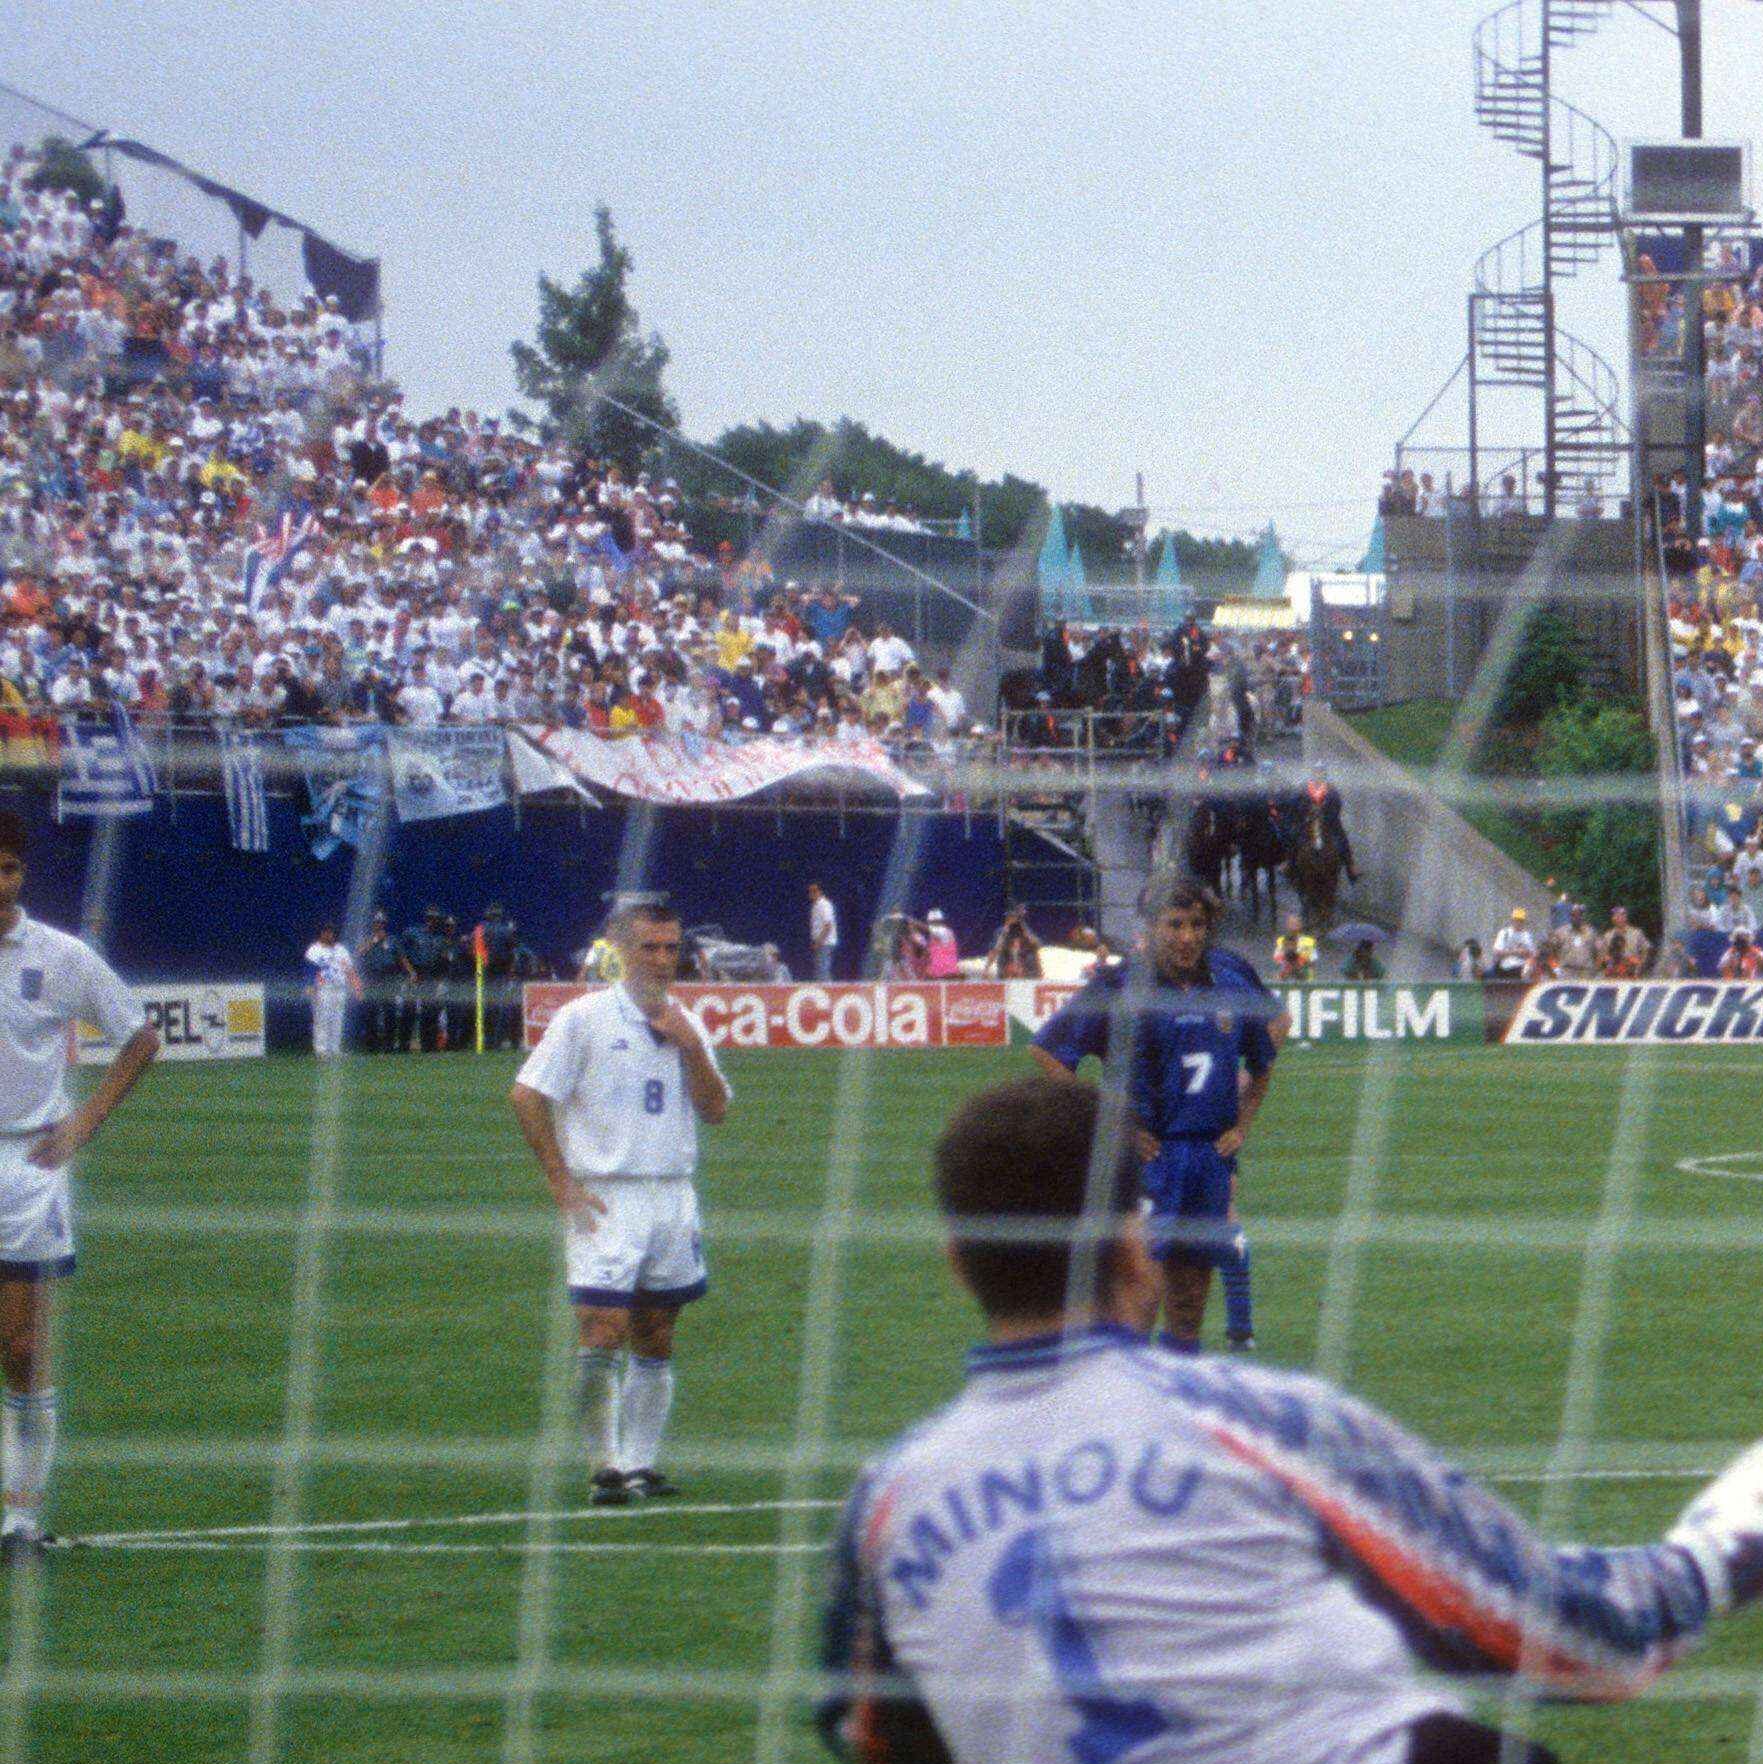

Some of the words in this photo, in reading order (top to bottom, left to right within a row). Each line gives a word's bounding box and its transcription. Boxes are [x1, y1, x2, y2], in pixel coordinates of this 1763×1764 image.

[144, 1000, 202, 1043] PEL
[694, 987, 927, 1044] ca-Cola
[1271, 989, 1450, 1039] IFILM
[1182, 1052, 1213, 1094] 7
[645, 1078, 664, 1115] 8
[891, 1439, 1204, 1610] MINOU
